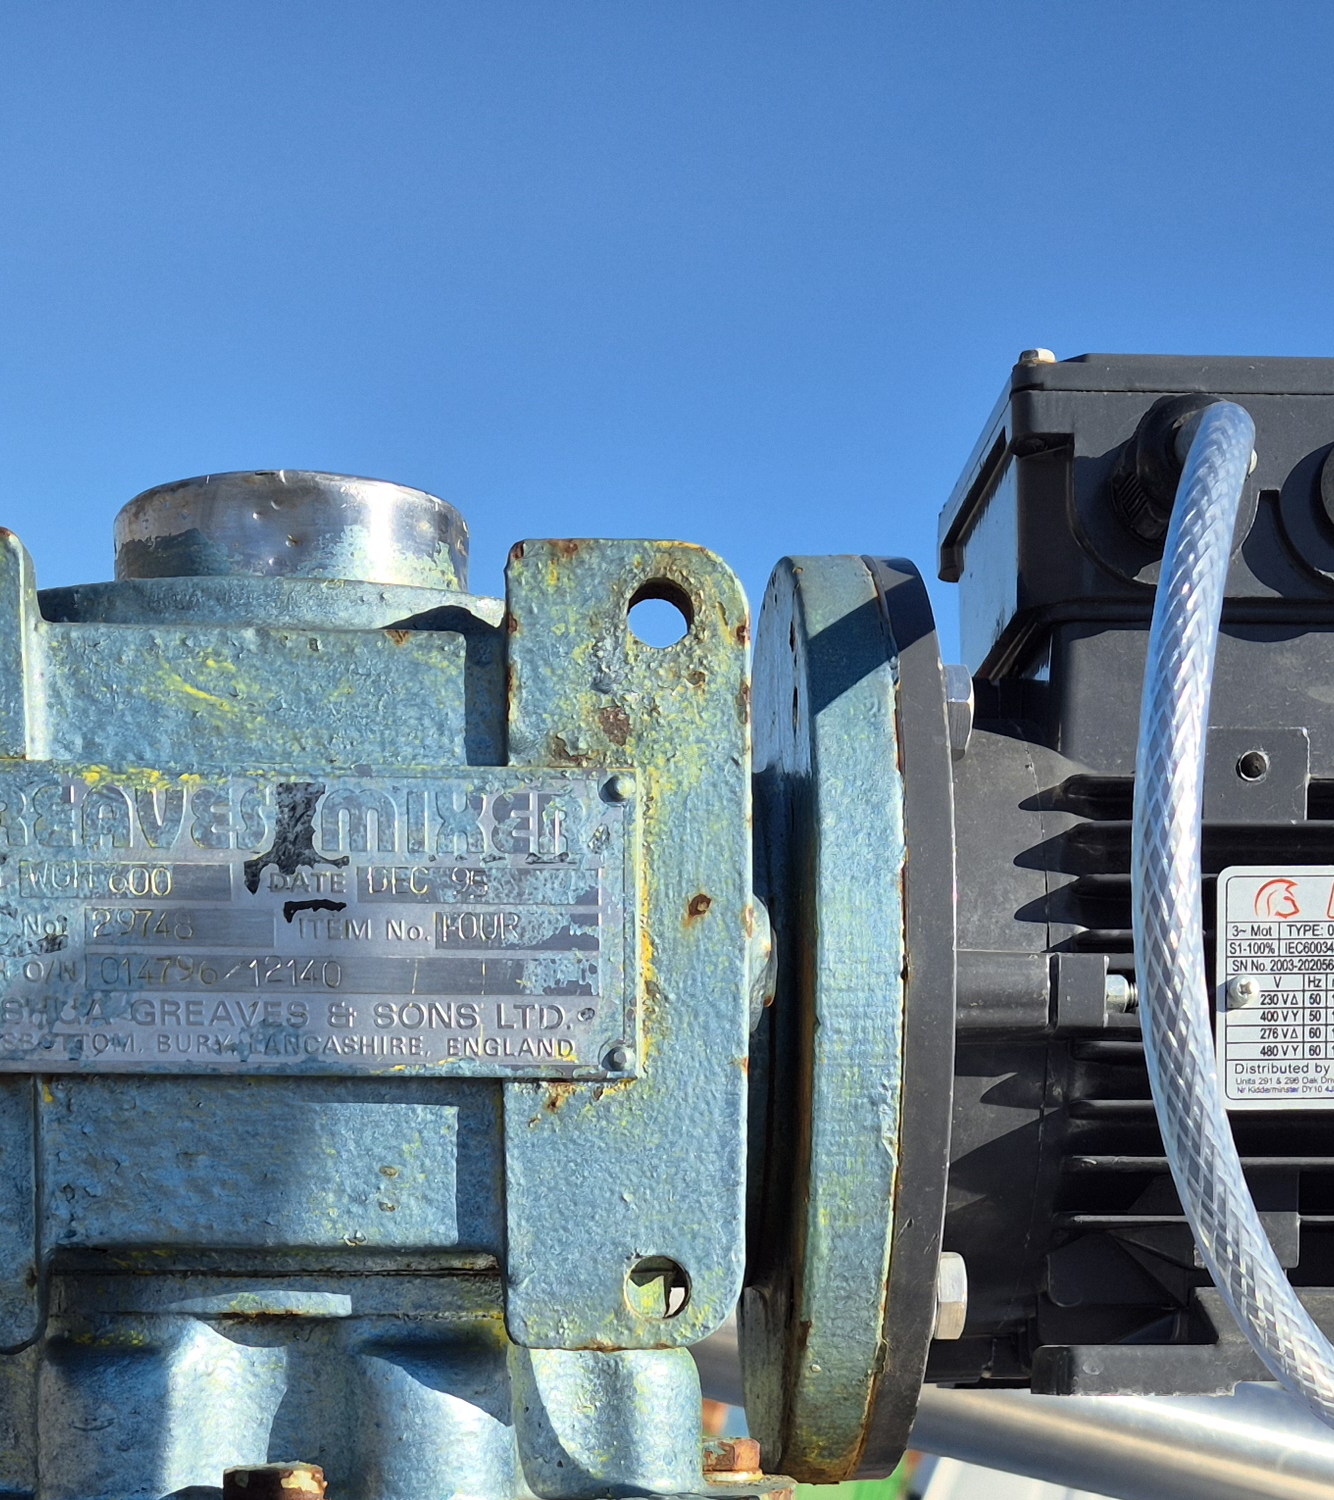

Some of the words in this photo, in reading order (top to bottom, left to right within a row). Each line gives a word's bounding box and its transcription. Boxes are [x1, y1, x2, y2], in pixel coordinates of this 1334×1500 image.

[321, 787, 585, 855] MIXER
[109, 864, 173, 896] 600
[269, 872, 348, 894] DATE
[366, 866, 429, 894] DEC
[451, 867, 490, 897] 95
[92, 908, 194, 941] 29748
[297, 918, 372, 941] ITEM
[386, 919, 431, 941] No.
[441, 913, 520, 942] FOUR
[1250, 924, 1273, 937] Mot
[1287, 924, 1324, 936] TYPE:
[1229, 942, 1275, 955] S1-100%
[1285, 941, 1334, 954] IEC60034
[22, 956, 77, 984] O/N
[1232, 960, 1248, 972] SN
[1250, 960, 1268, 972] No.
[1273, 976, 1282, 989] V
[1308, 976, 1322, 988] Hz
[1260, 993, 1279, 1006] 230
[1308, 993, 1322, 1006] 50
[130, 999, 309, 1028] GREAVES
[326, 1001, 357, 1028] &
[373, 1002, 479, 1030] SONS
[496, 1003, 574, 1031] LTD.
[1260, 1010, 1279, 1022] 400
[1308, 1010, 1322, 1022] 50
[1260, 1027, 1279, 1039] 276
[1308, 1027, 1322, 1039] 60
[446, 1037, 576, 1058] ENGLAND
[1260, 1044, 1279, 1057] 480
[1308, 1044, 1322, 1057] 60
[1234, 1062, 1310, 1075] Distributed
[1314, 1062, 1331, 1077] by
[1235, 1077, 1256, 1085] Units
[1258, 1077, 1273, 1085] 291
[1276, 1077, 1282, 1085] &
[1302, 1076, 1318, 1084] Oak
[1302, 1085, 1322, 1093] DY10
